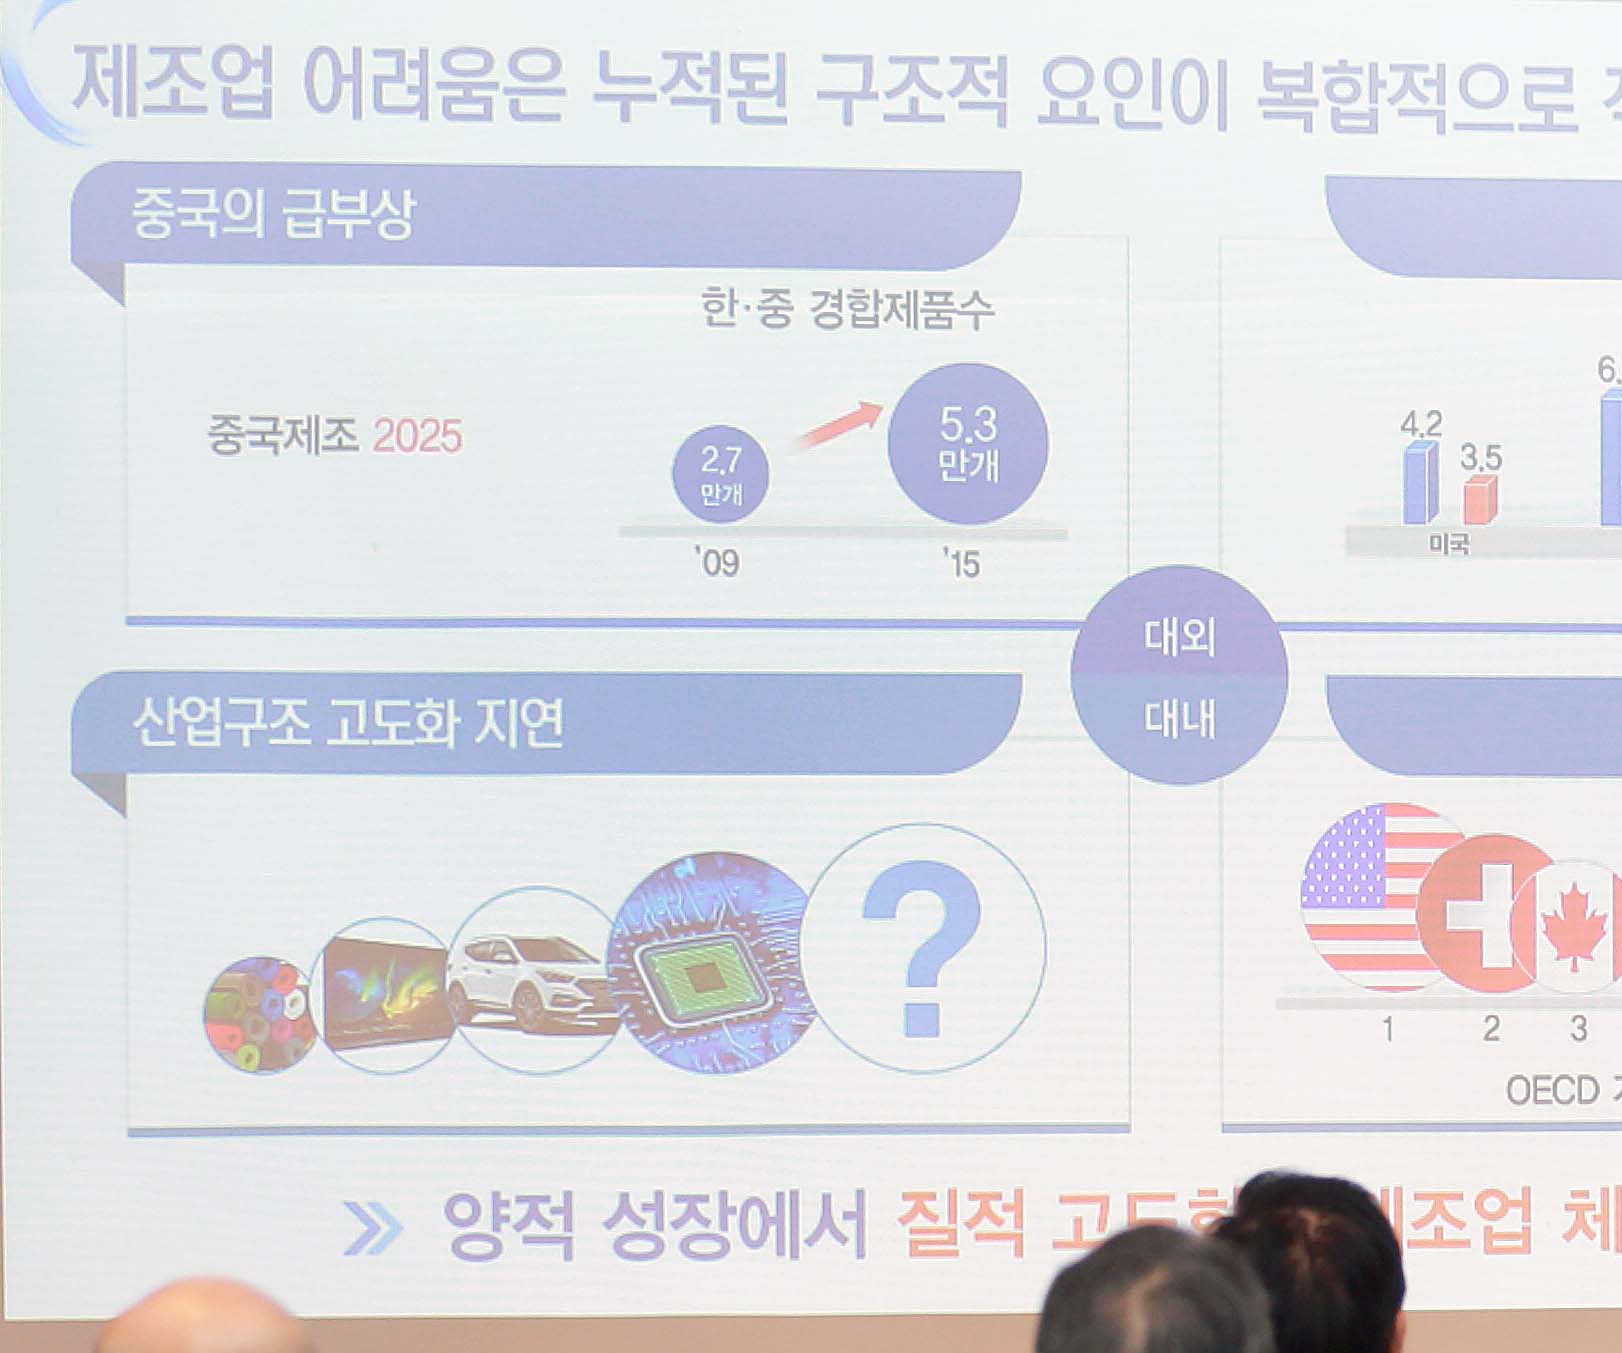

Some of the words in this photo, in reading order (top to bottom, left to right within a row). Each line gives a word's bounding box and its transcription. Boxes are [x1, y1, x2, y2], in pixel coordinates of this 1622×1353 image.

[72, 42, 275, 120] 제조업
[304, 45, 567, 122] 어려움은
[592, 49, 788, 126] 누적된
[816, 54, 1008, 129] 구조적
[1037, 56, 1228, 133] 요인이
[1257, 58, 1580, 137] 복합적으로
[132, 187, 265, 239] 중국의
[282, 188, 418, 241] 급부상
[810, 288, 996, 332] 경합제품수
[207, 414, 360, 457] 중국제조
[373, 416, 463, 453] 2025
[941, 404, 998, 445] 5.3
[1400, 410, 1444, 439] 4.2
[701, 445, 743, 476] 2.7
[939, 447, 999, 484] 만개
[1460, 442, 1503, 473] 3.5
[700, 483, 743, 508] 만개
[1429, 532, 1470, 556] 미국
[1144, 616, 1215, 658] 대외
[133, 695, 313, 748] 산업구조
[326, 697, 462, 750] 고도화
[474, 697, 563, 750] 지연
[1143, 698, 1215, 740] 대내
[1383, 1015, 1392, 1042] 1
[1483, 1014, 1500, 1042] 2
[1570, 1014, 1588, 1042] 3
[1506, 1073, 1601, 1106] OECD
[443, 1190, 574, 1263] 양적
[602, 1187, 866, 1262] 성장에서
[897, 1187, 1024, 1259] 질적
